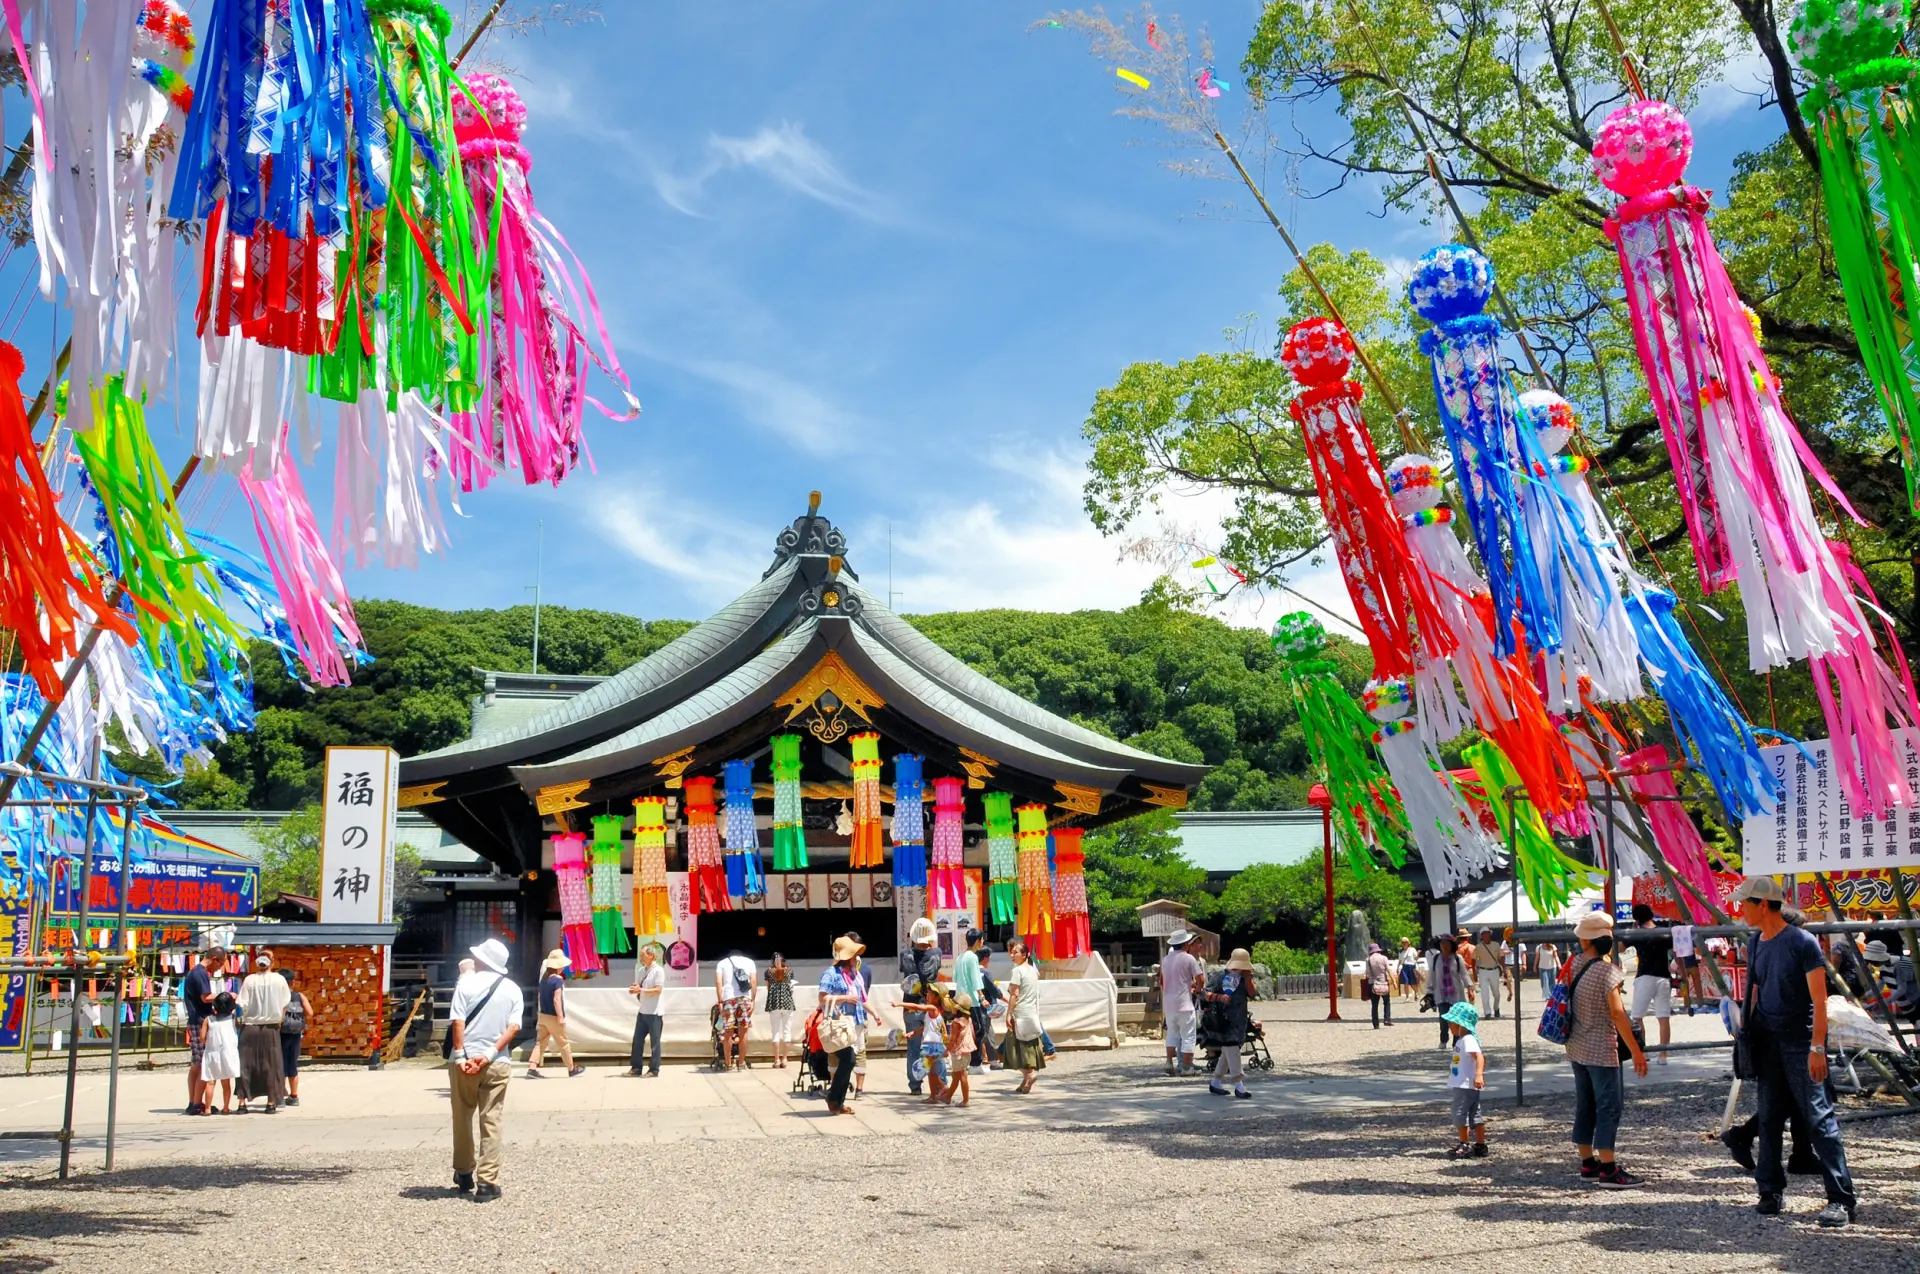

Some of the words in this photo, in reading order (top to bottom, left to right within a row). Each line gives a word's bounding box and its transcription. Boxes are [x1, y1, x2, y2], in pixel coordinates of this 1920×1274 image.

[333, 771, 375, 904] 福の神
[1816, 749, 1828, 861] 株式会社ベストサポート
